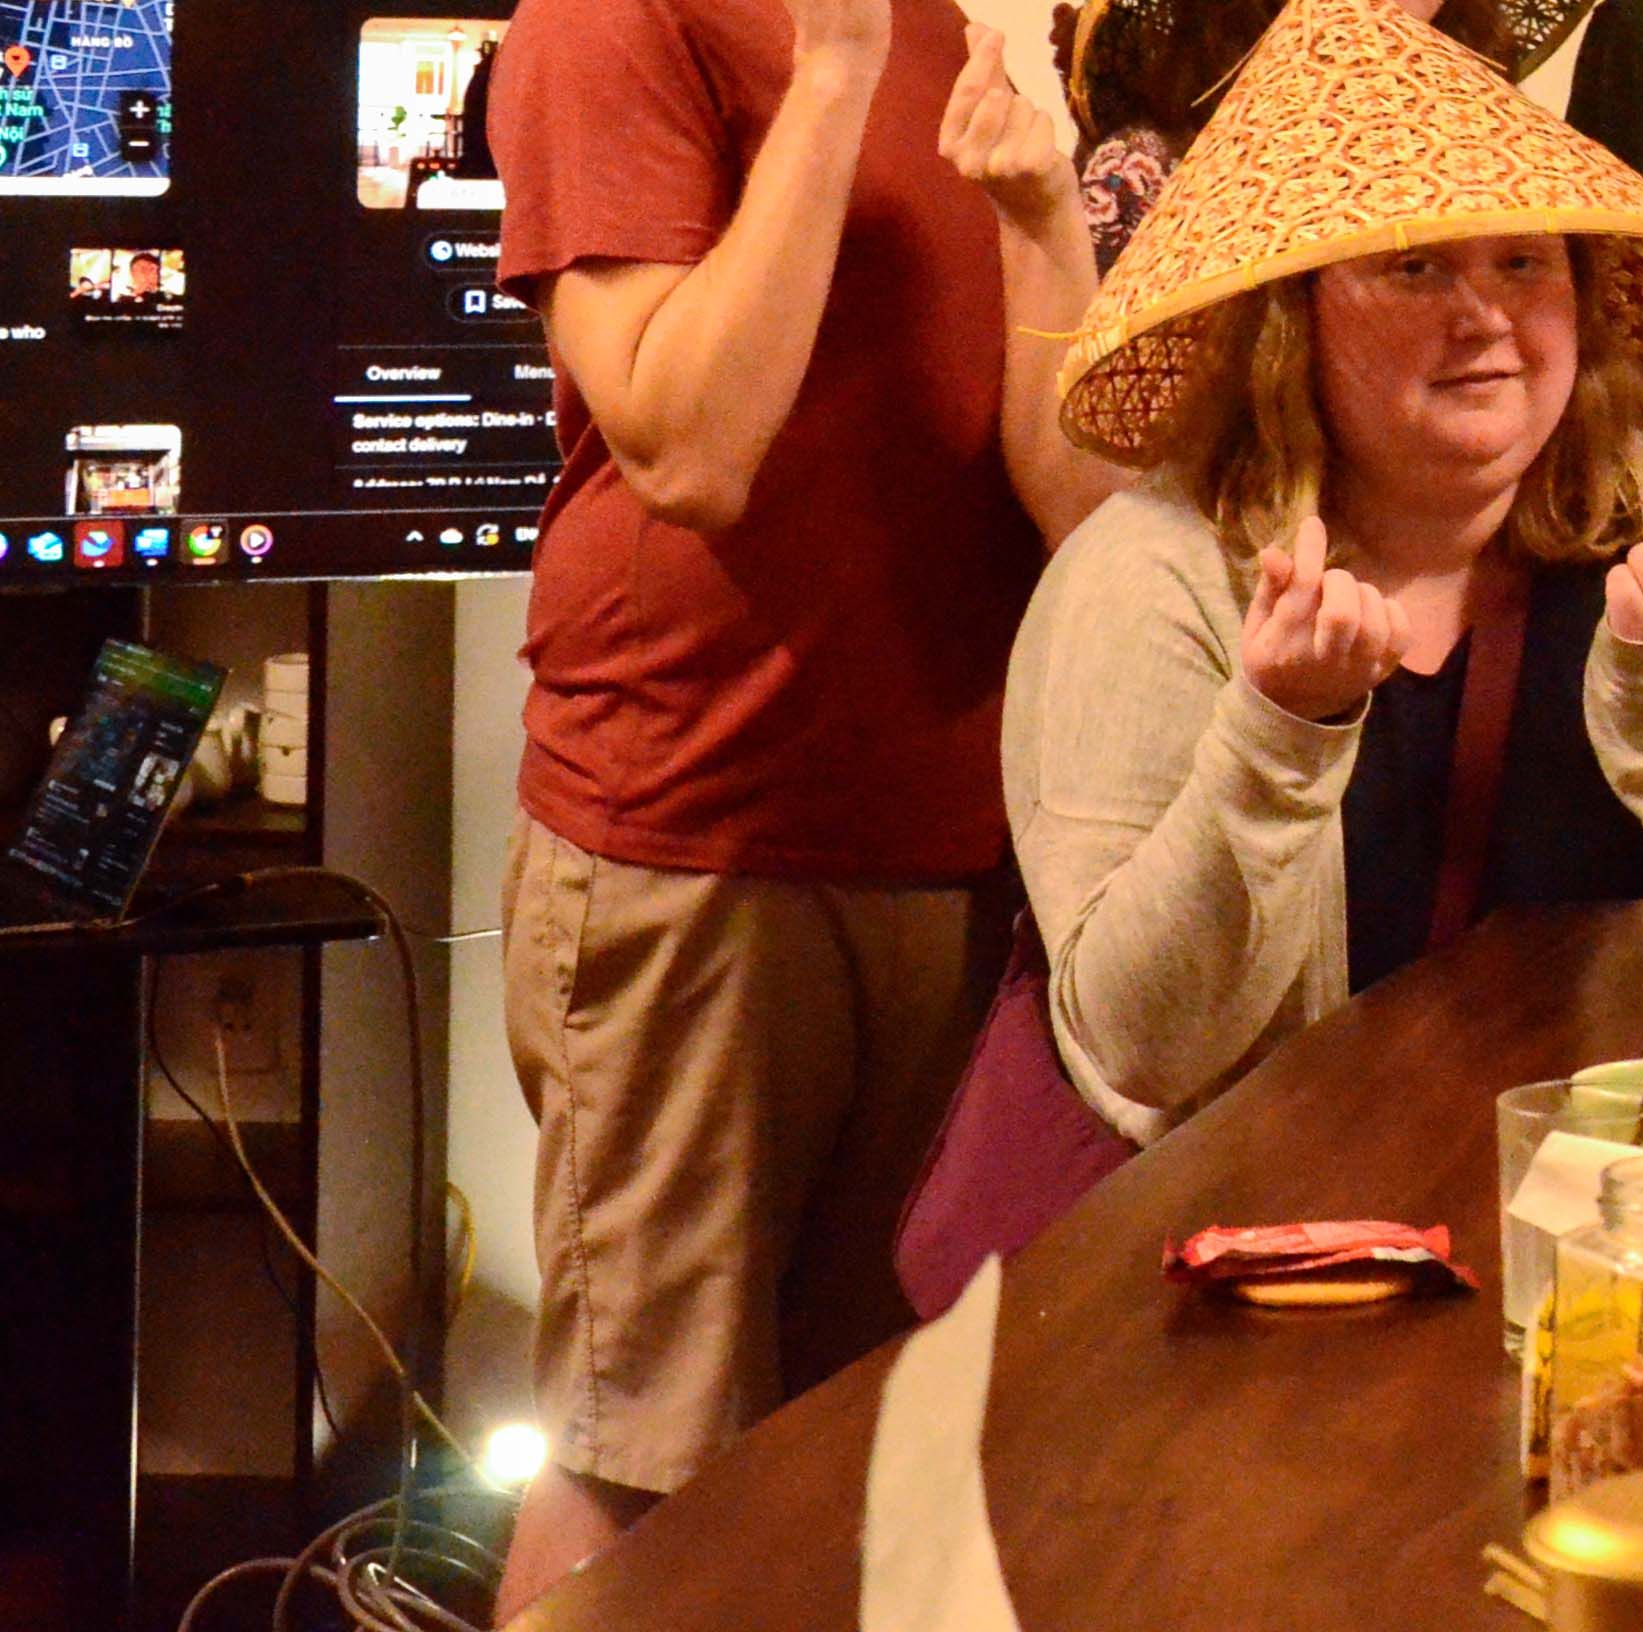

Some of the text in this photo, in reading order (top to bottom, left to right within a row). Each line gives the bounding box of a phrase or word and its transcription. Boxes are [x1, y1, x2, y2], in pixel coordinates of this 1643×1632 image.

[6, 102, 43, 117] Nam
[10, 324, 47, 340] who
[366, 365, 442, 381] Overview
[352, 413, 413, 429] Service
[414, 412, 480, 431] options:
[481, 411, 535, 427] Dine-in
[352, 436, 468, 455] contact delivery
